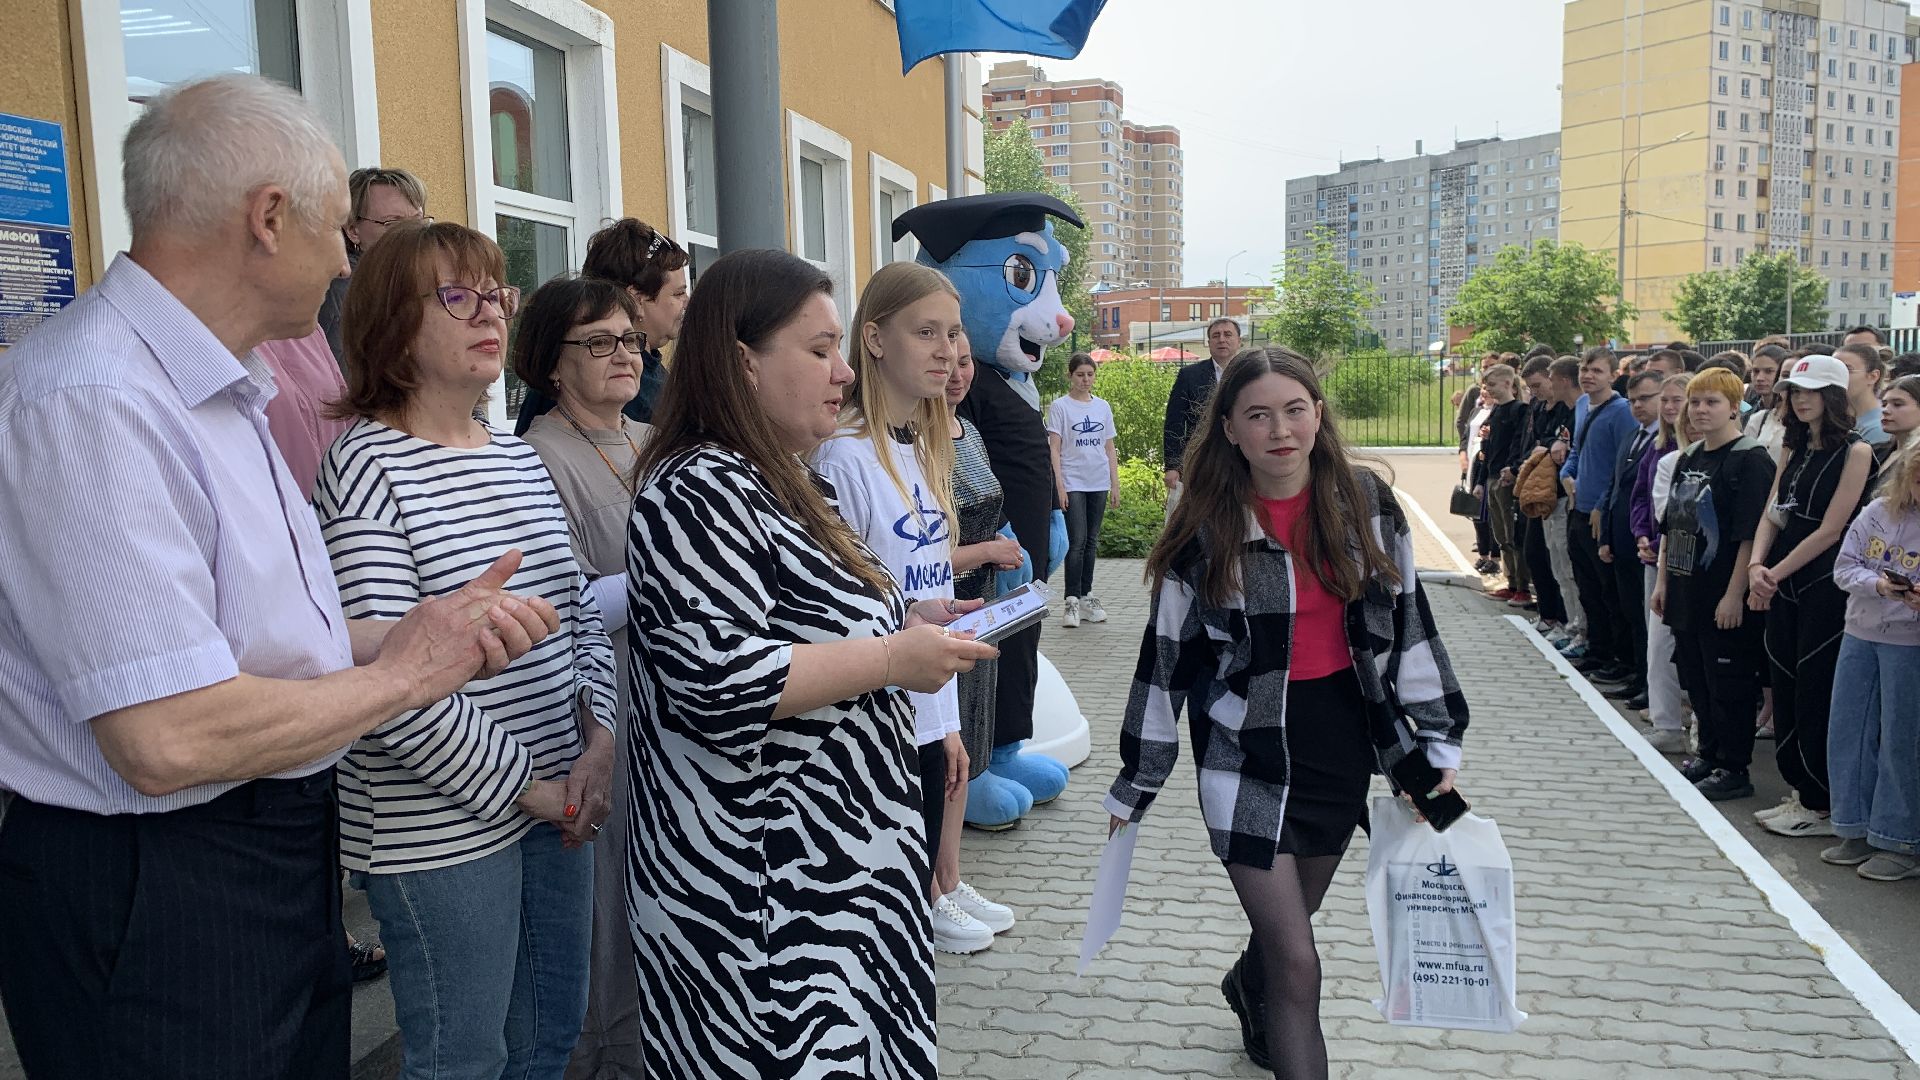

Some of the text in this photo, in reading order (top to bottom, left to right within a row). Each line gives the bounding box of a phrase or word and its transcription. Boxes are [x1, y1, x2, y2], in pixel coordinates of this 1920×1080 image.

[1417, 961, 1484, 972] www.mfua.ru
[1413, 972, 1489, 987] (495) 221-10-01
